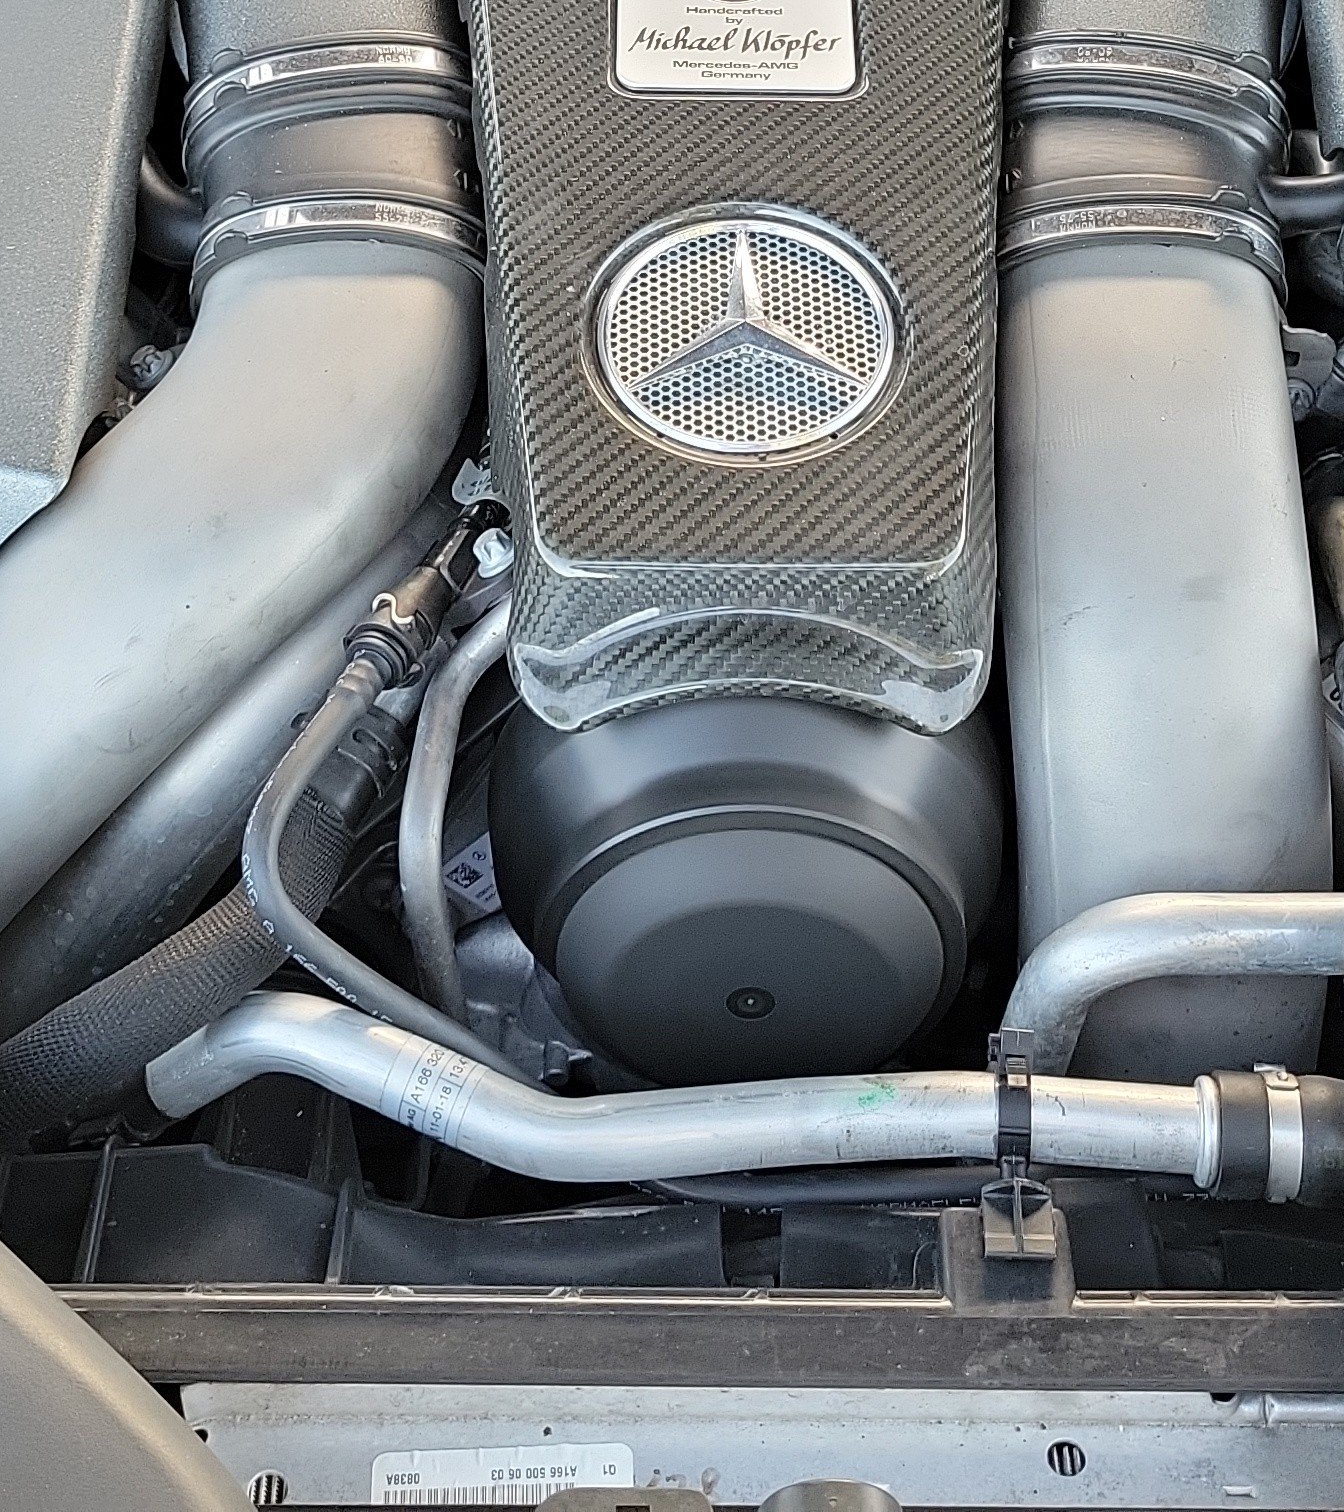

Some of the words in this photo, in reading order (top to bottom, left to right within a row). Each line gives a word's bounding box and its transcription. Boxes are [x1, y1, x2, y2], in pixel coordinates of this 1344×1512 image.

[686, 6, 784, 16] Handcrafted
[725, 16, 744, 26] by
[628, 26, 739, 54] Michael
[672, 61, 799, 71] Mercedes-AMG
[701, 71, 771, 81] Germany
[242, 854, 258, 907] AMG
[410, 1068, 432, 1104] A166
[490, 1469, 504, 1481] 03
[508, 1468, 522, 1480] 06
[525, 1467, 546, 1479] 500
[550, 1465, 577, 1478] A166
[386, 1472, 420, 1486] 0838A
